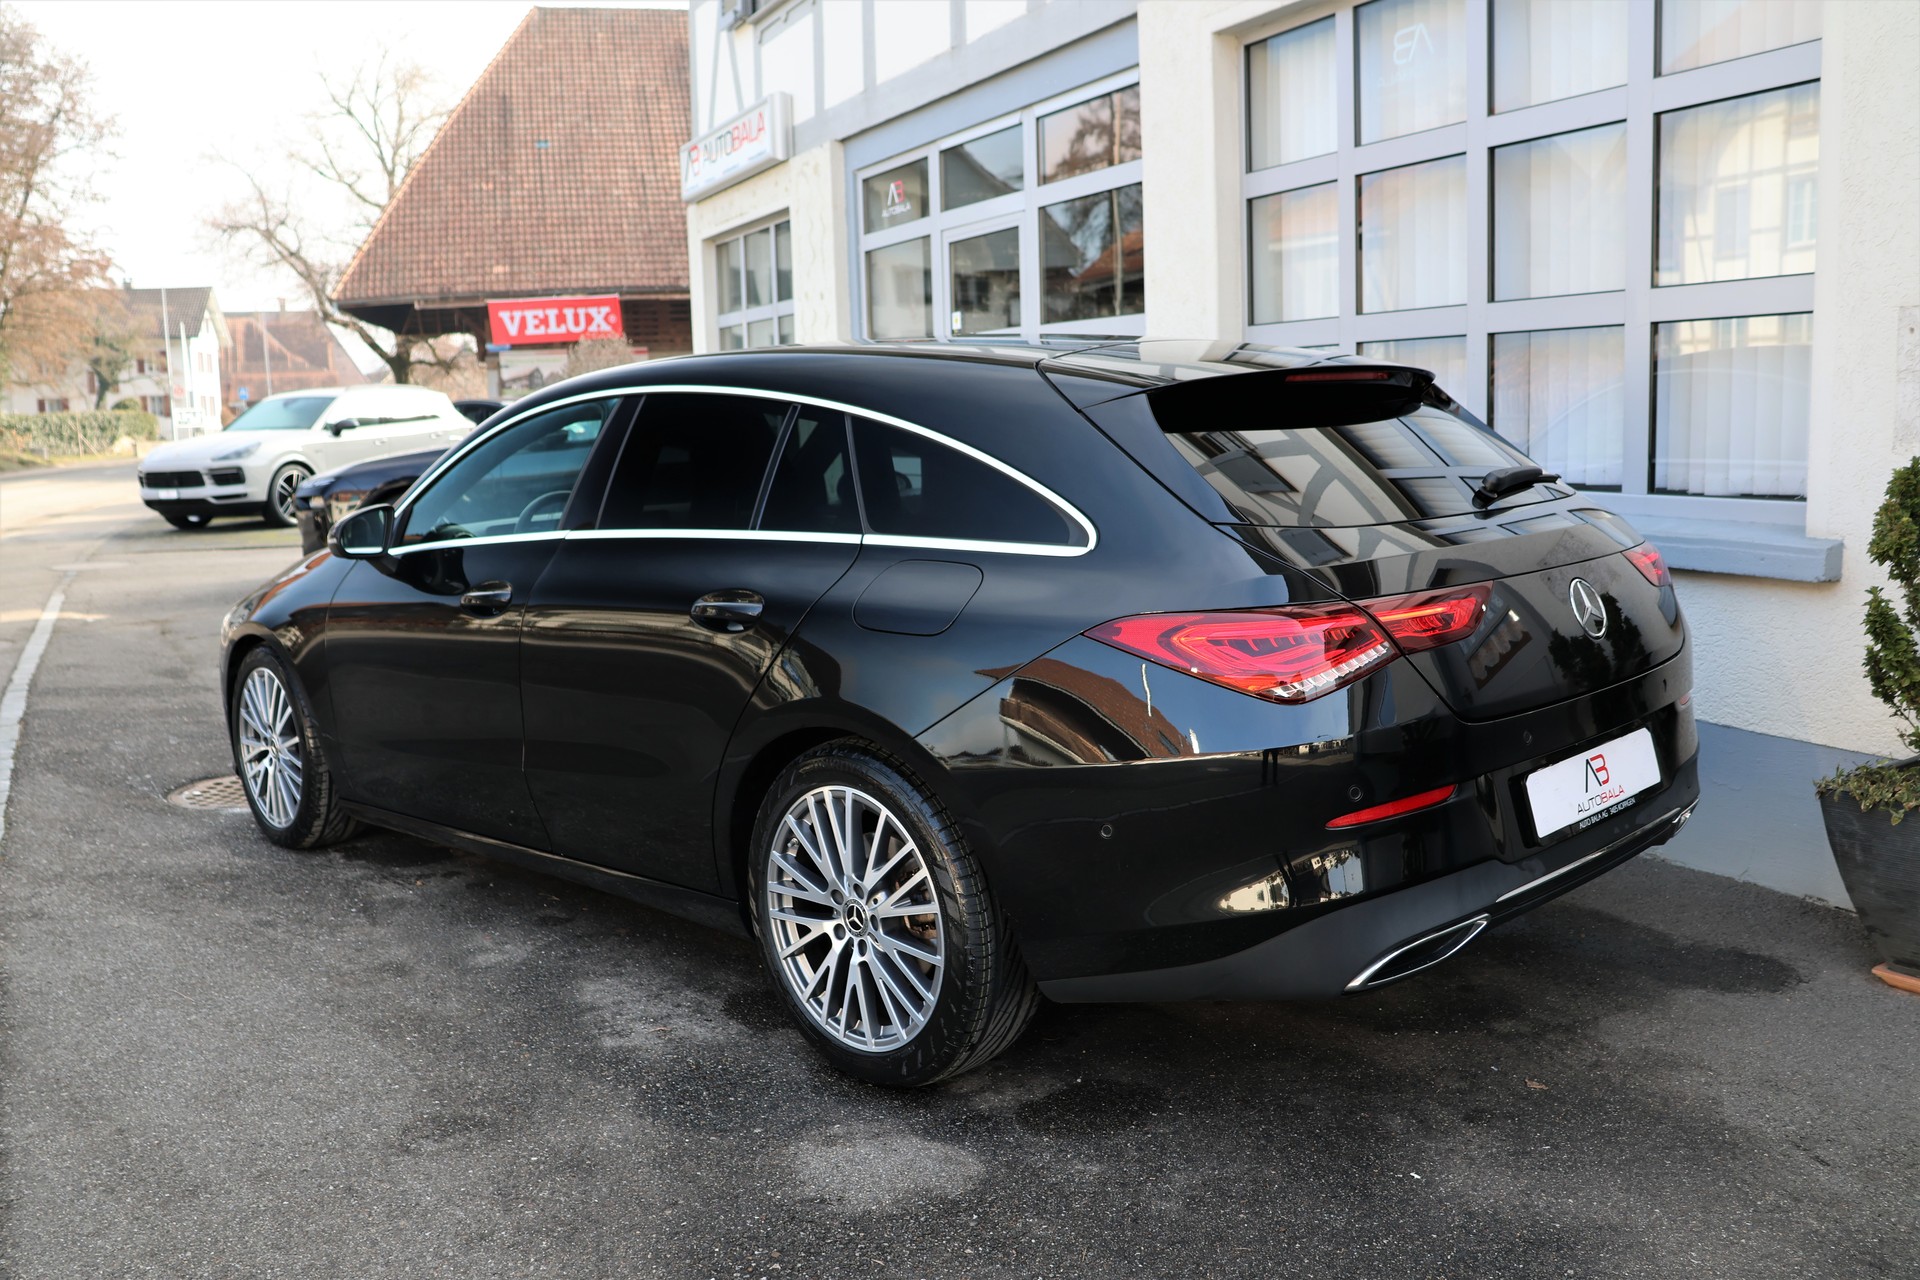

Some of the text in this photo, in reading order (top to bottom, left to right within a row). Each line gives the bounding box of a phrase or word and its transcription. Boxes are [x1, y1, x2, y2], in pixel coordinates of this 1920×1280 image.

[703, 111, 766, 164] AUTOBALA
[498, 305, 612, 337] VELUX
[1577, 784, 1625, 815] AUTOBALA
